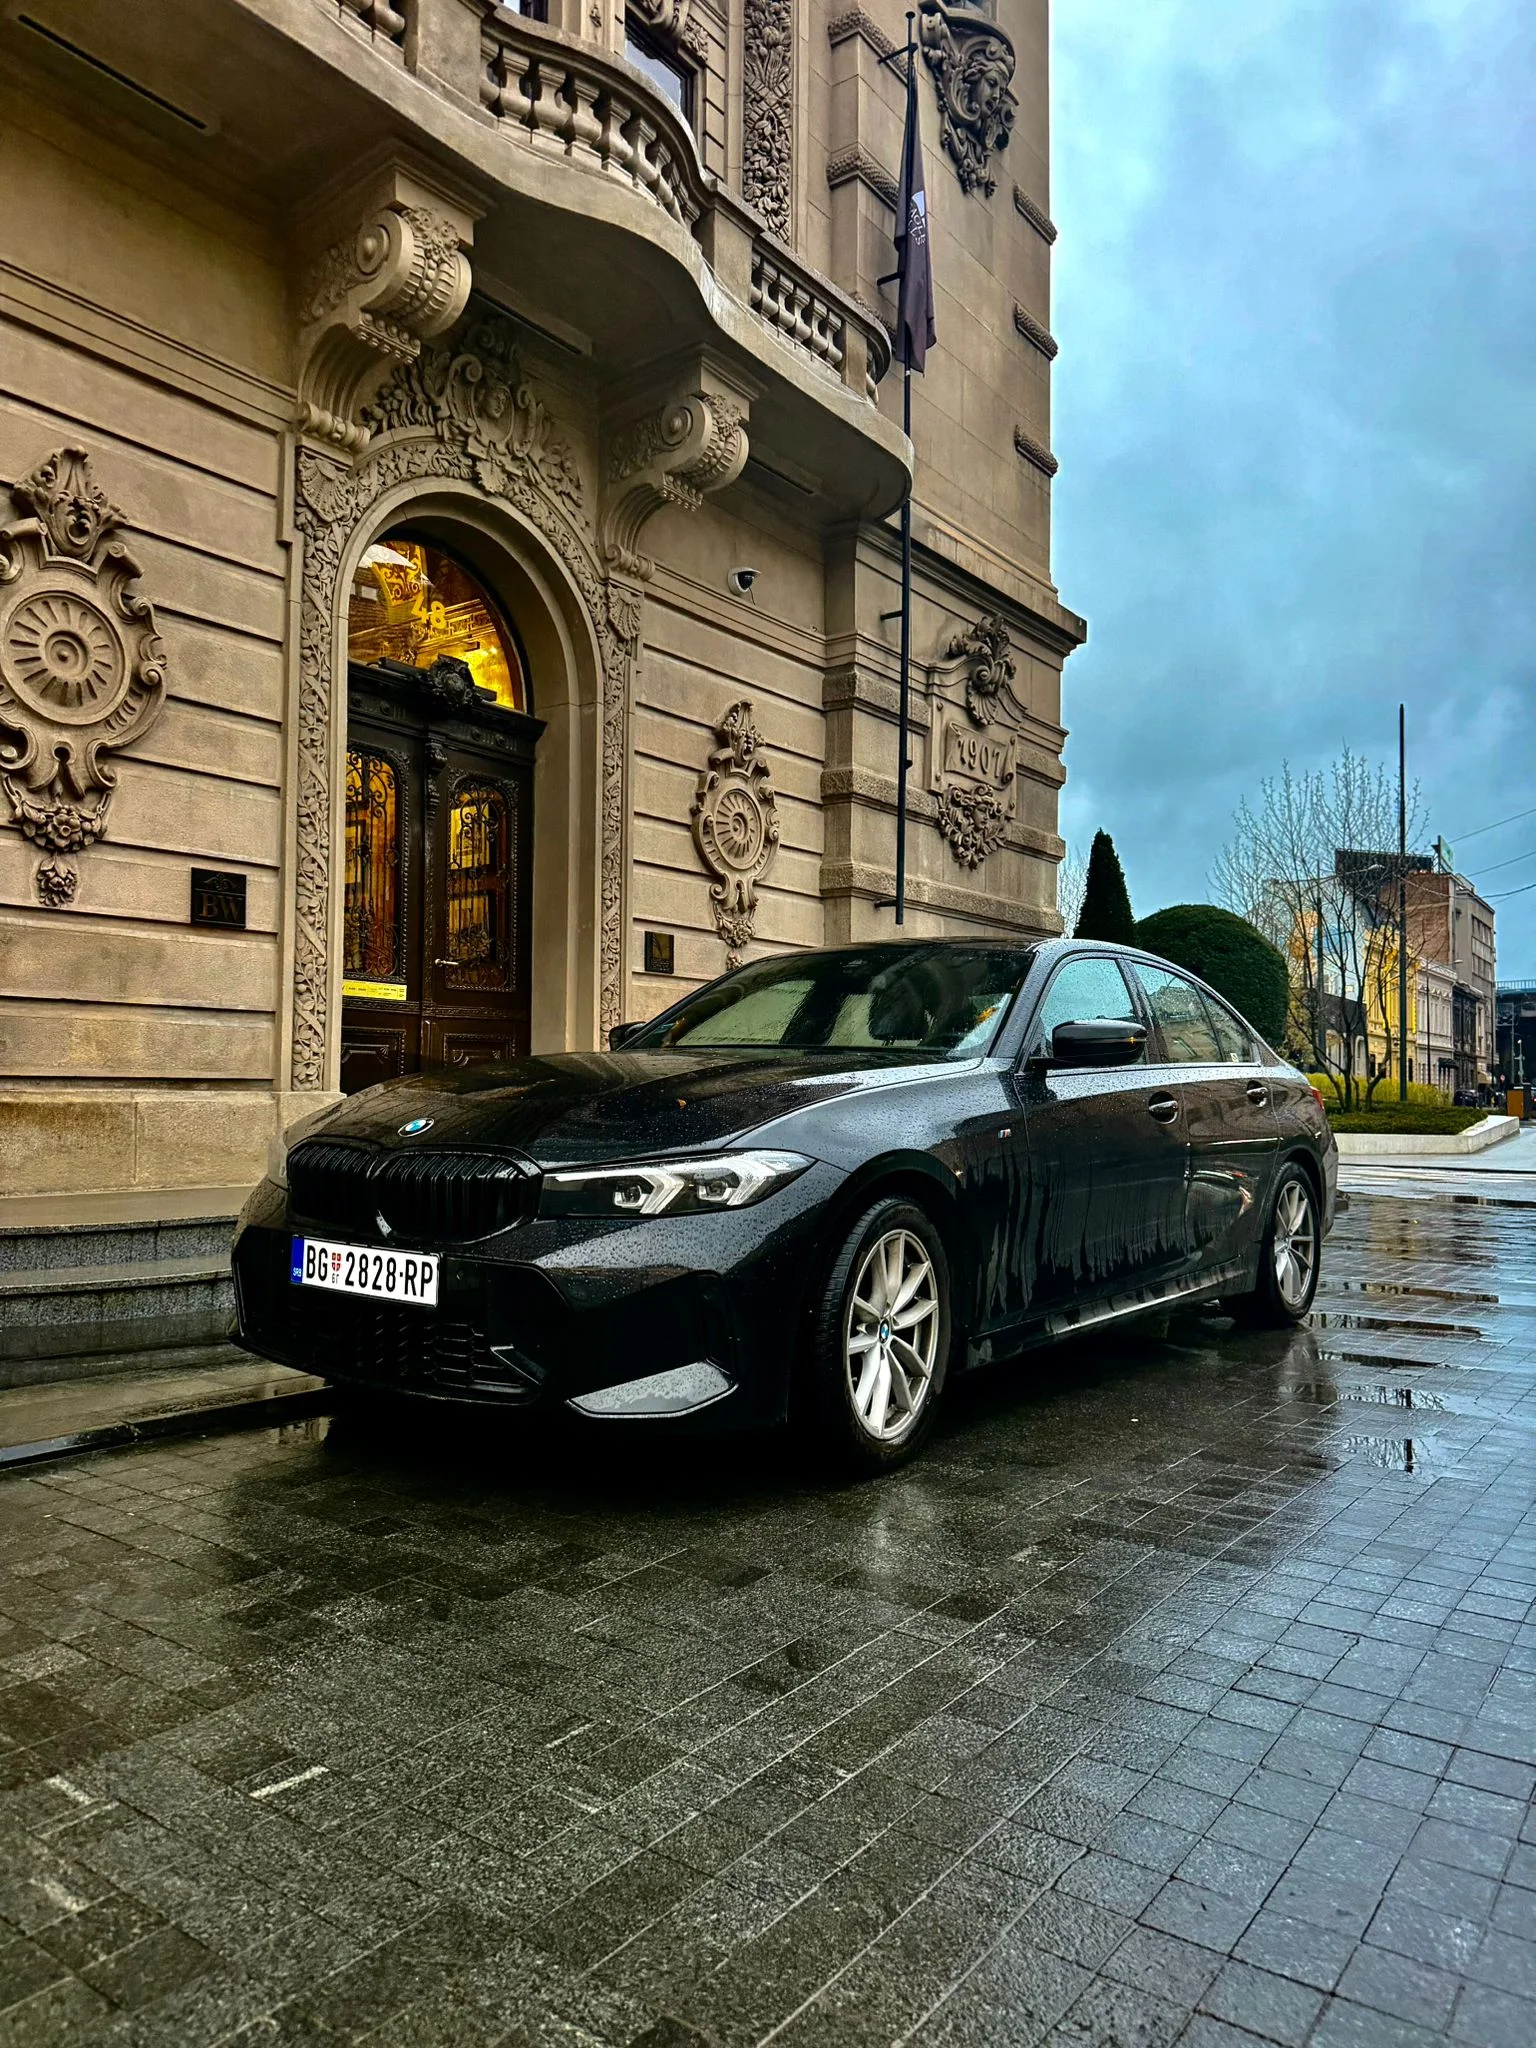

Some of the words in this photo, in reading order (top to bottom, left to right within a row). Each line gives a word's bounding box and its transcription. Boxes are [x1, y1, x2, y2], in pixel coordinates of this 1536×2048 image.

[411, 594, 447, 629] 48
[957, 736, 1000, 779] 1907
[292, 1267, 302, 1277] SRB
[306, 1245, 328, 1282] BG
